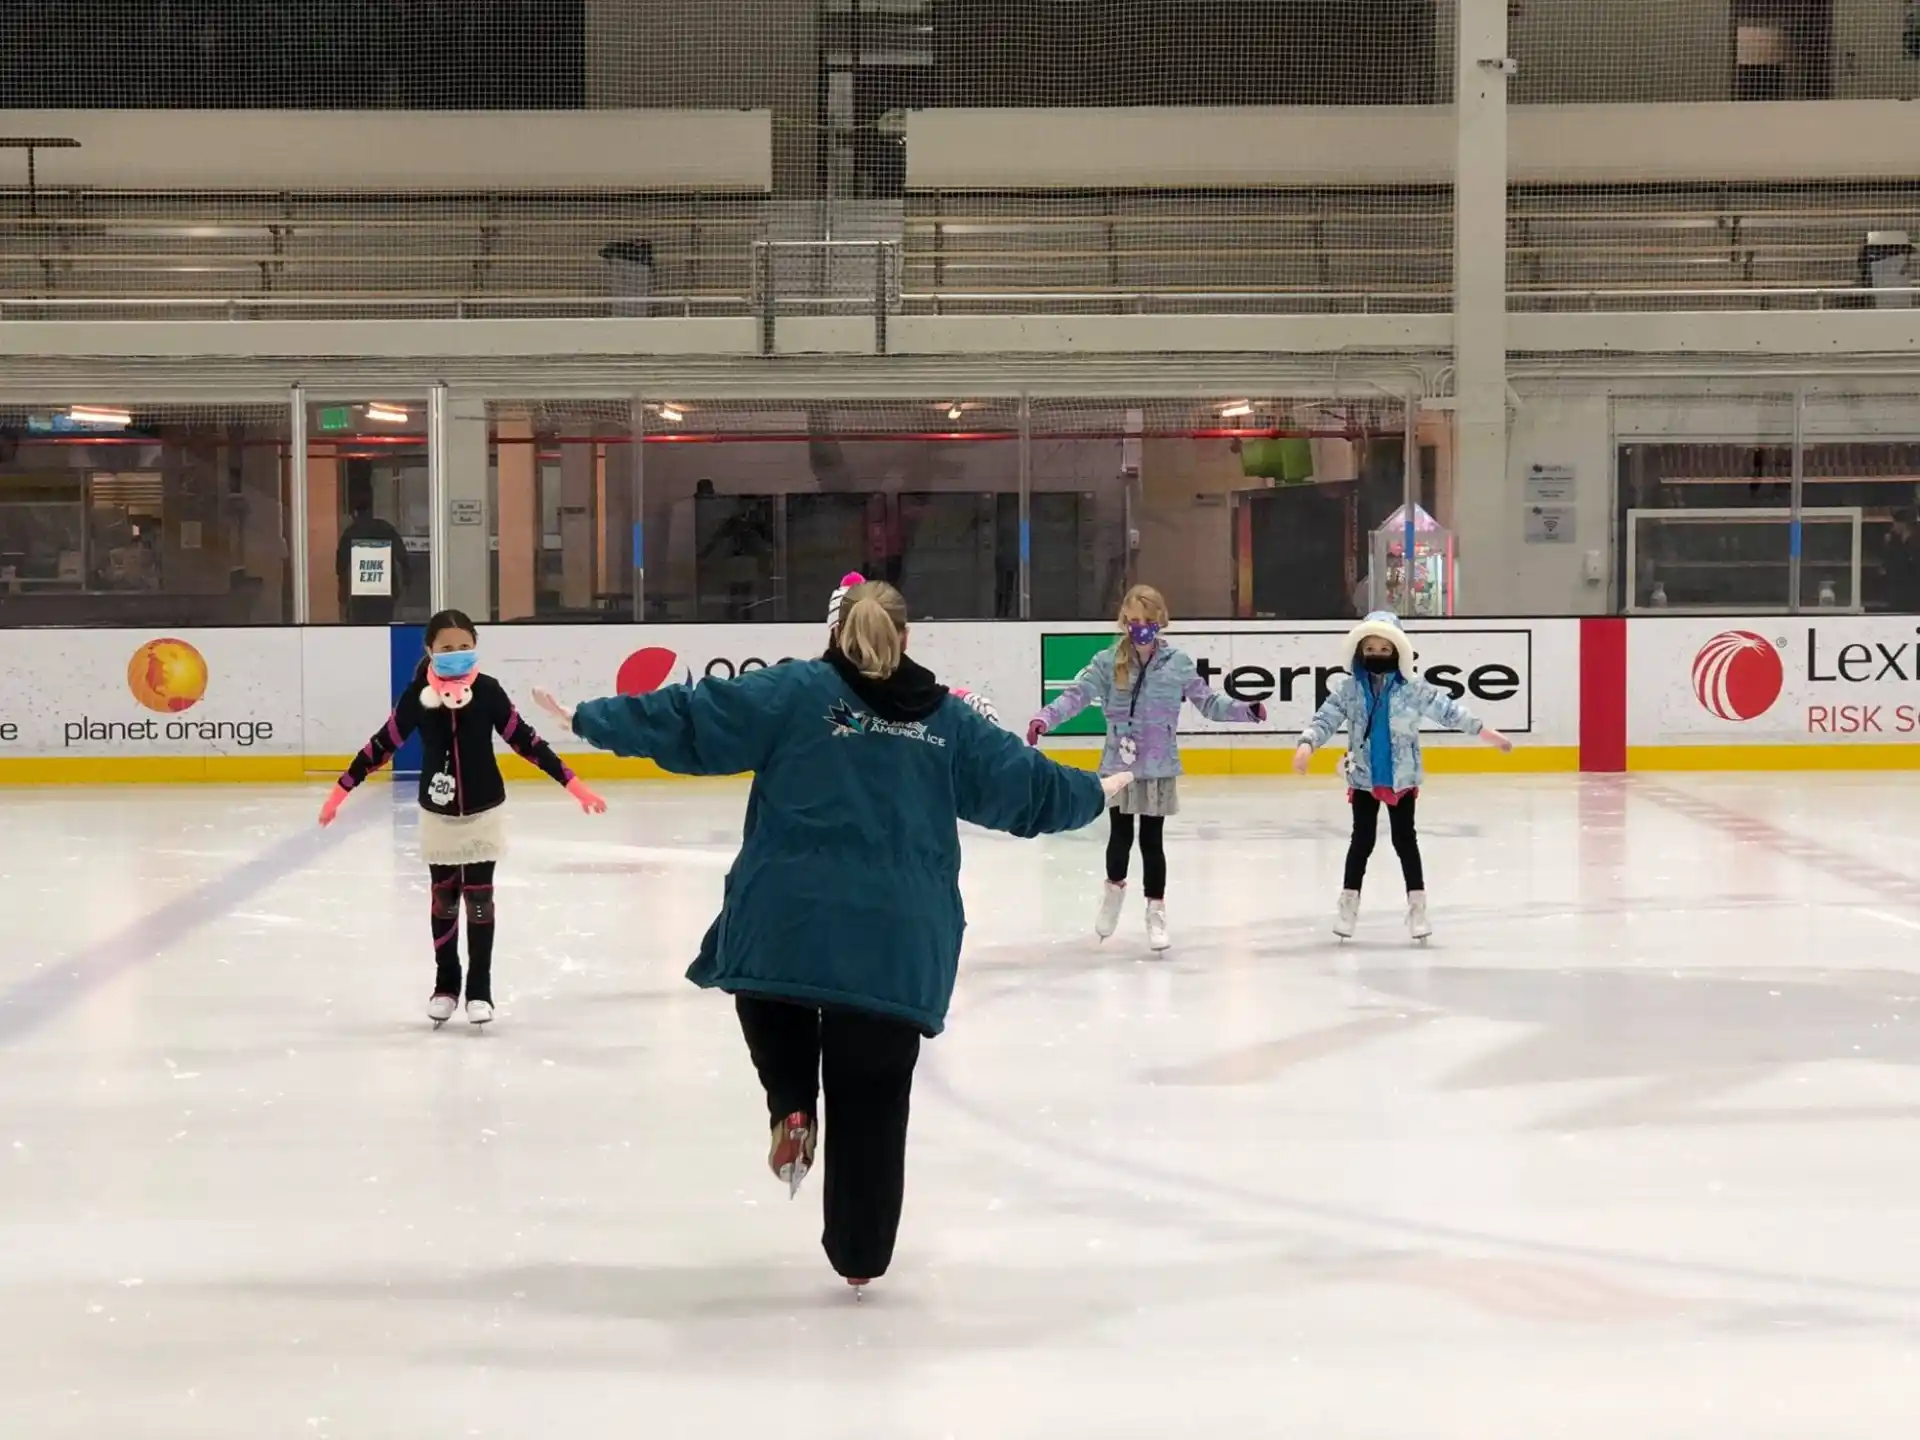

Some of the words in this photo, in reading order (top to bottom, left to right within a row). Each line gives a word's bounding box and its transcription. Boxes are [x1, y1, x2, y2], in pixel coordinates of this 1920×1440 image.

[359, 560, 384, 570] RINK
[360, 571, 384, 582] EXIT
[1808, 705, 1883, 733] RISK
[1894, 705, 1920, 733] S
[65, 716, 158, 747] planet
[166, 721, 273, 746] orange
[870, 723, 925, 741] AMERICA
[927, 733, 946, 747] ICE
[435, 779, 450, 795] 20
